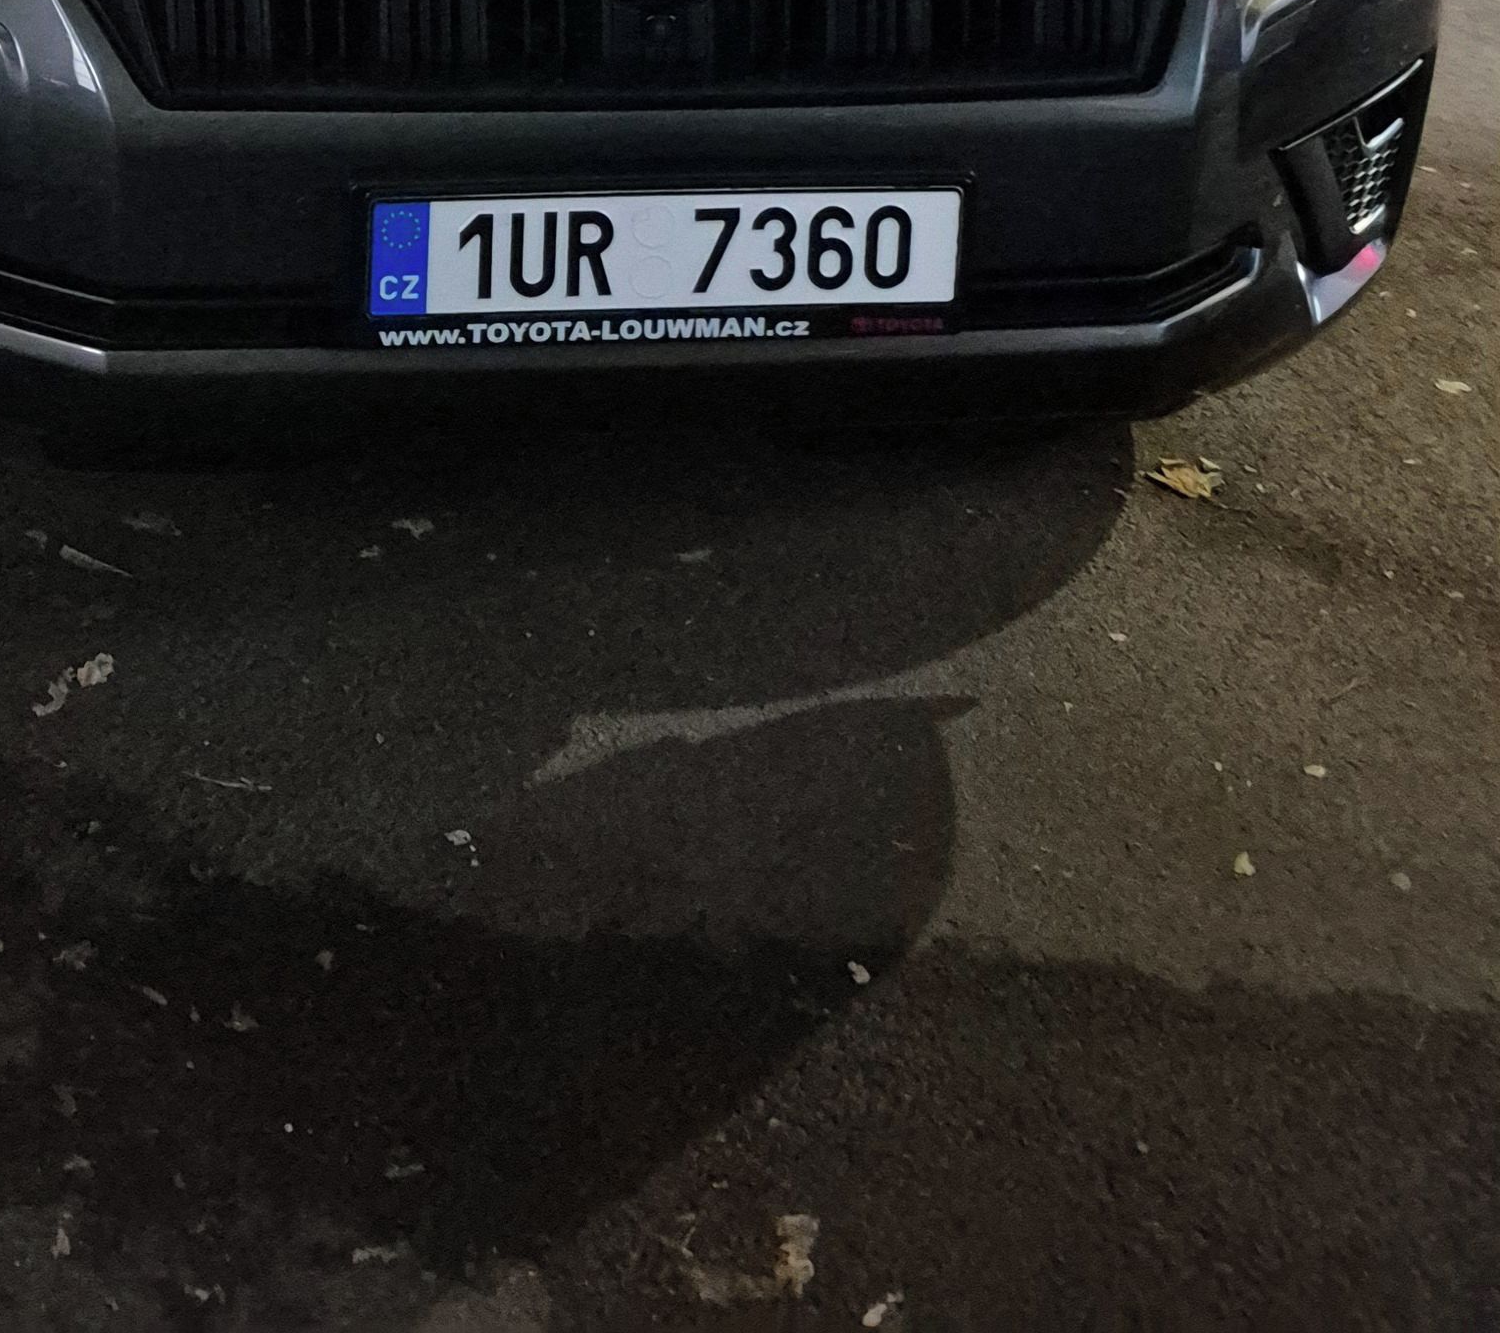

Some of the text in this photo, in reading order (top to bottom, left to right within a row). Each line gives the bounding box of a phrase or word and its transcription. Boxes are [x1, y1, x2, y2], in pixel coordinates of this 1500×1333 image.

[458, 204, 913, 300] 1UR 7360
[379, 274, 420, 301] CZ
[378, 317, 811, 347] www.TOYOTA-LOUWMAN.cz
